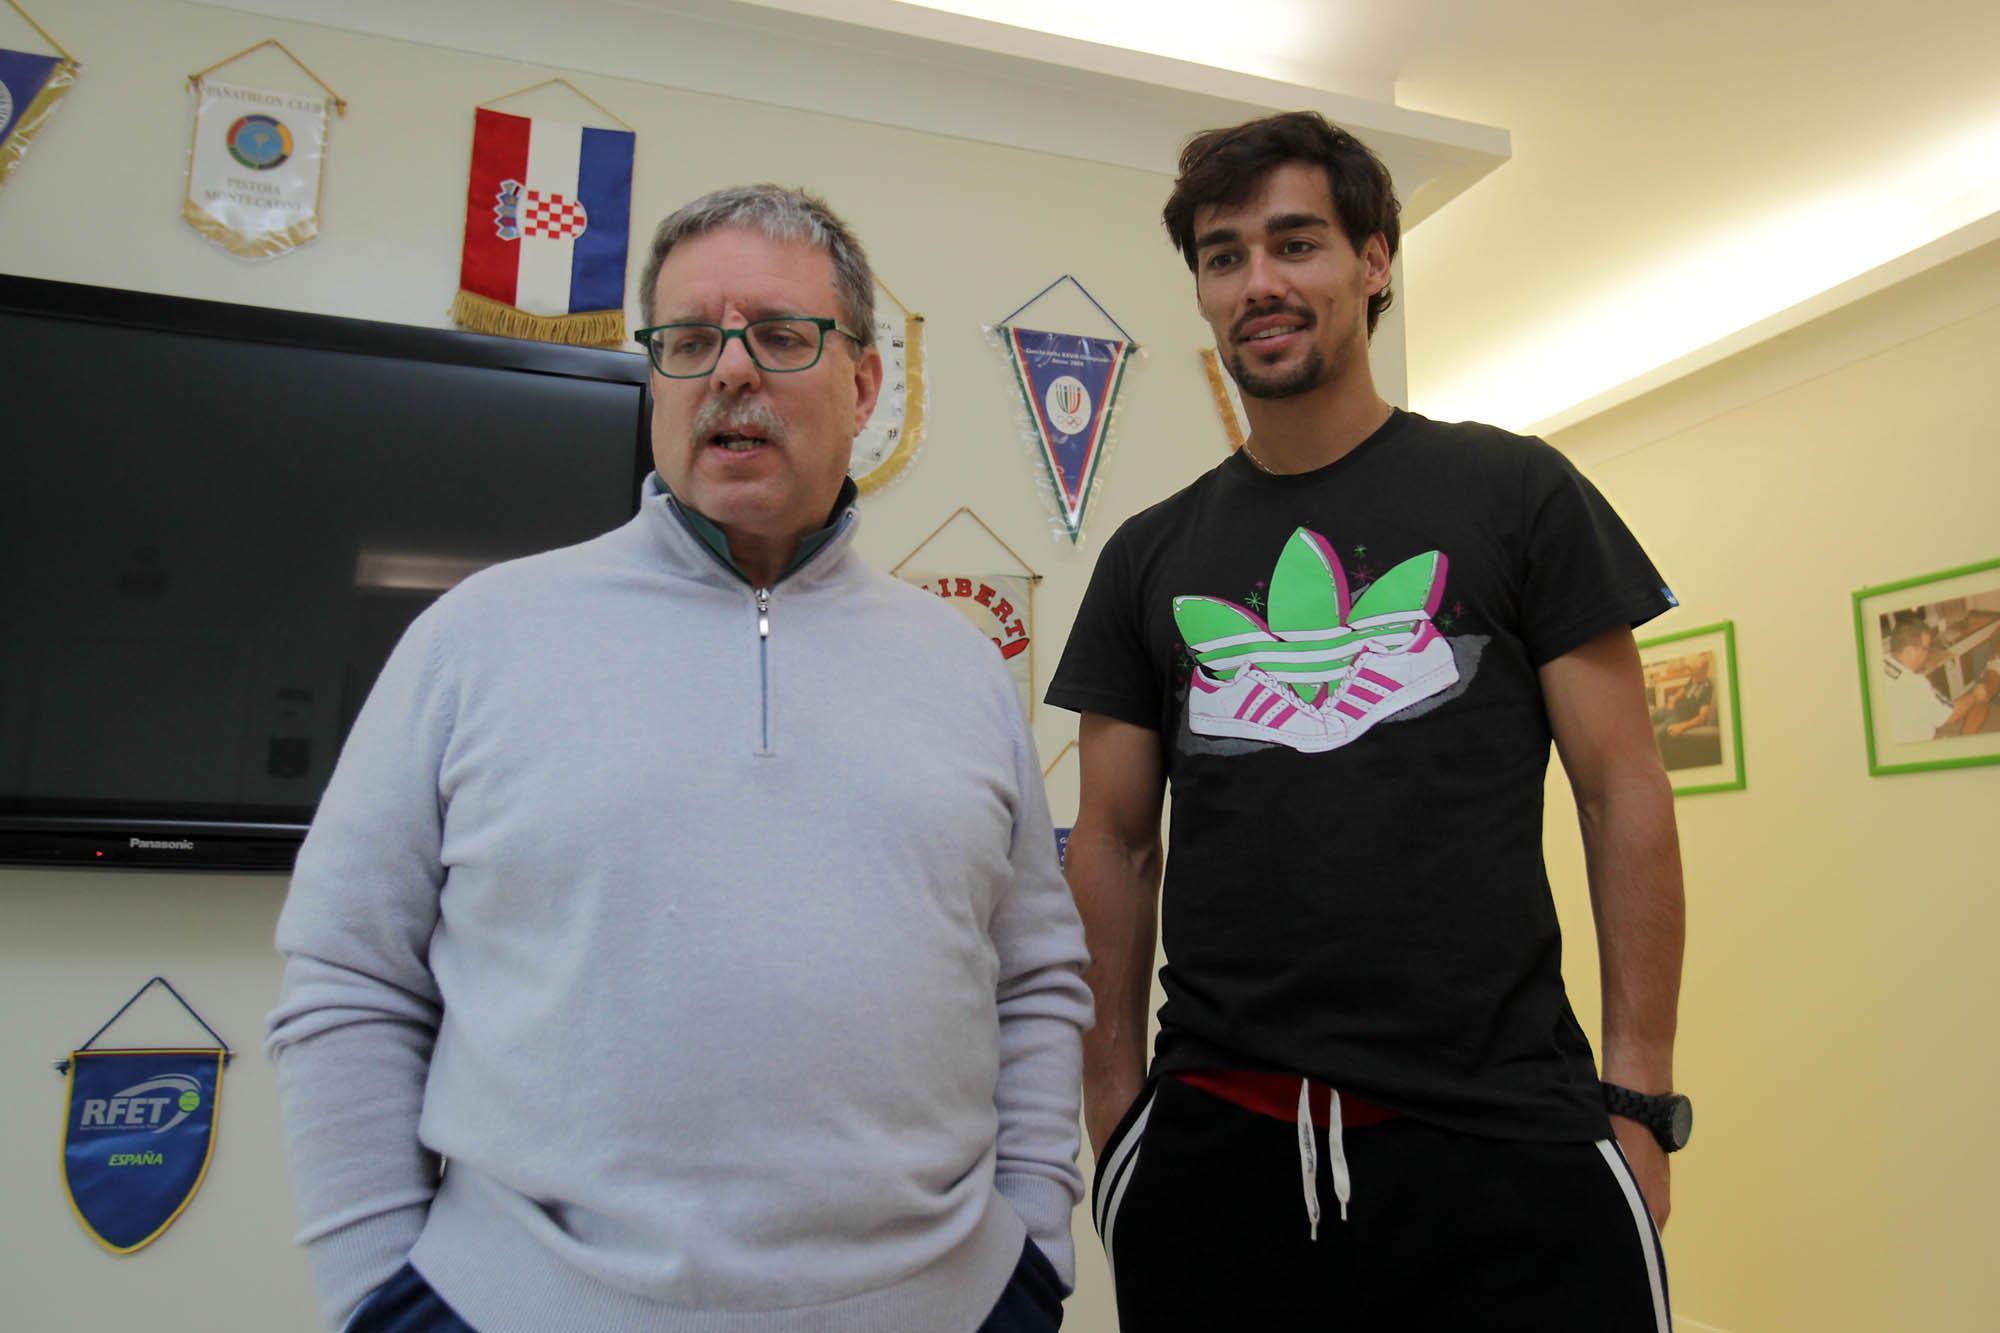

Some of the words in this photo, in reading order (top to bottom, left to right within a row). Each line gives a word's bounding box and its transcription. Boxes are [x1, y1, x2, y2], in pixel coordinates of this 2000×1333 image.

[130, 838, 194, 849] Panasonic
[80, 1097, 170, 1125] RFET
[108, 1151, 164, 1167] ESPAÑA
